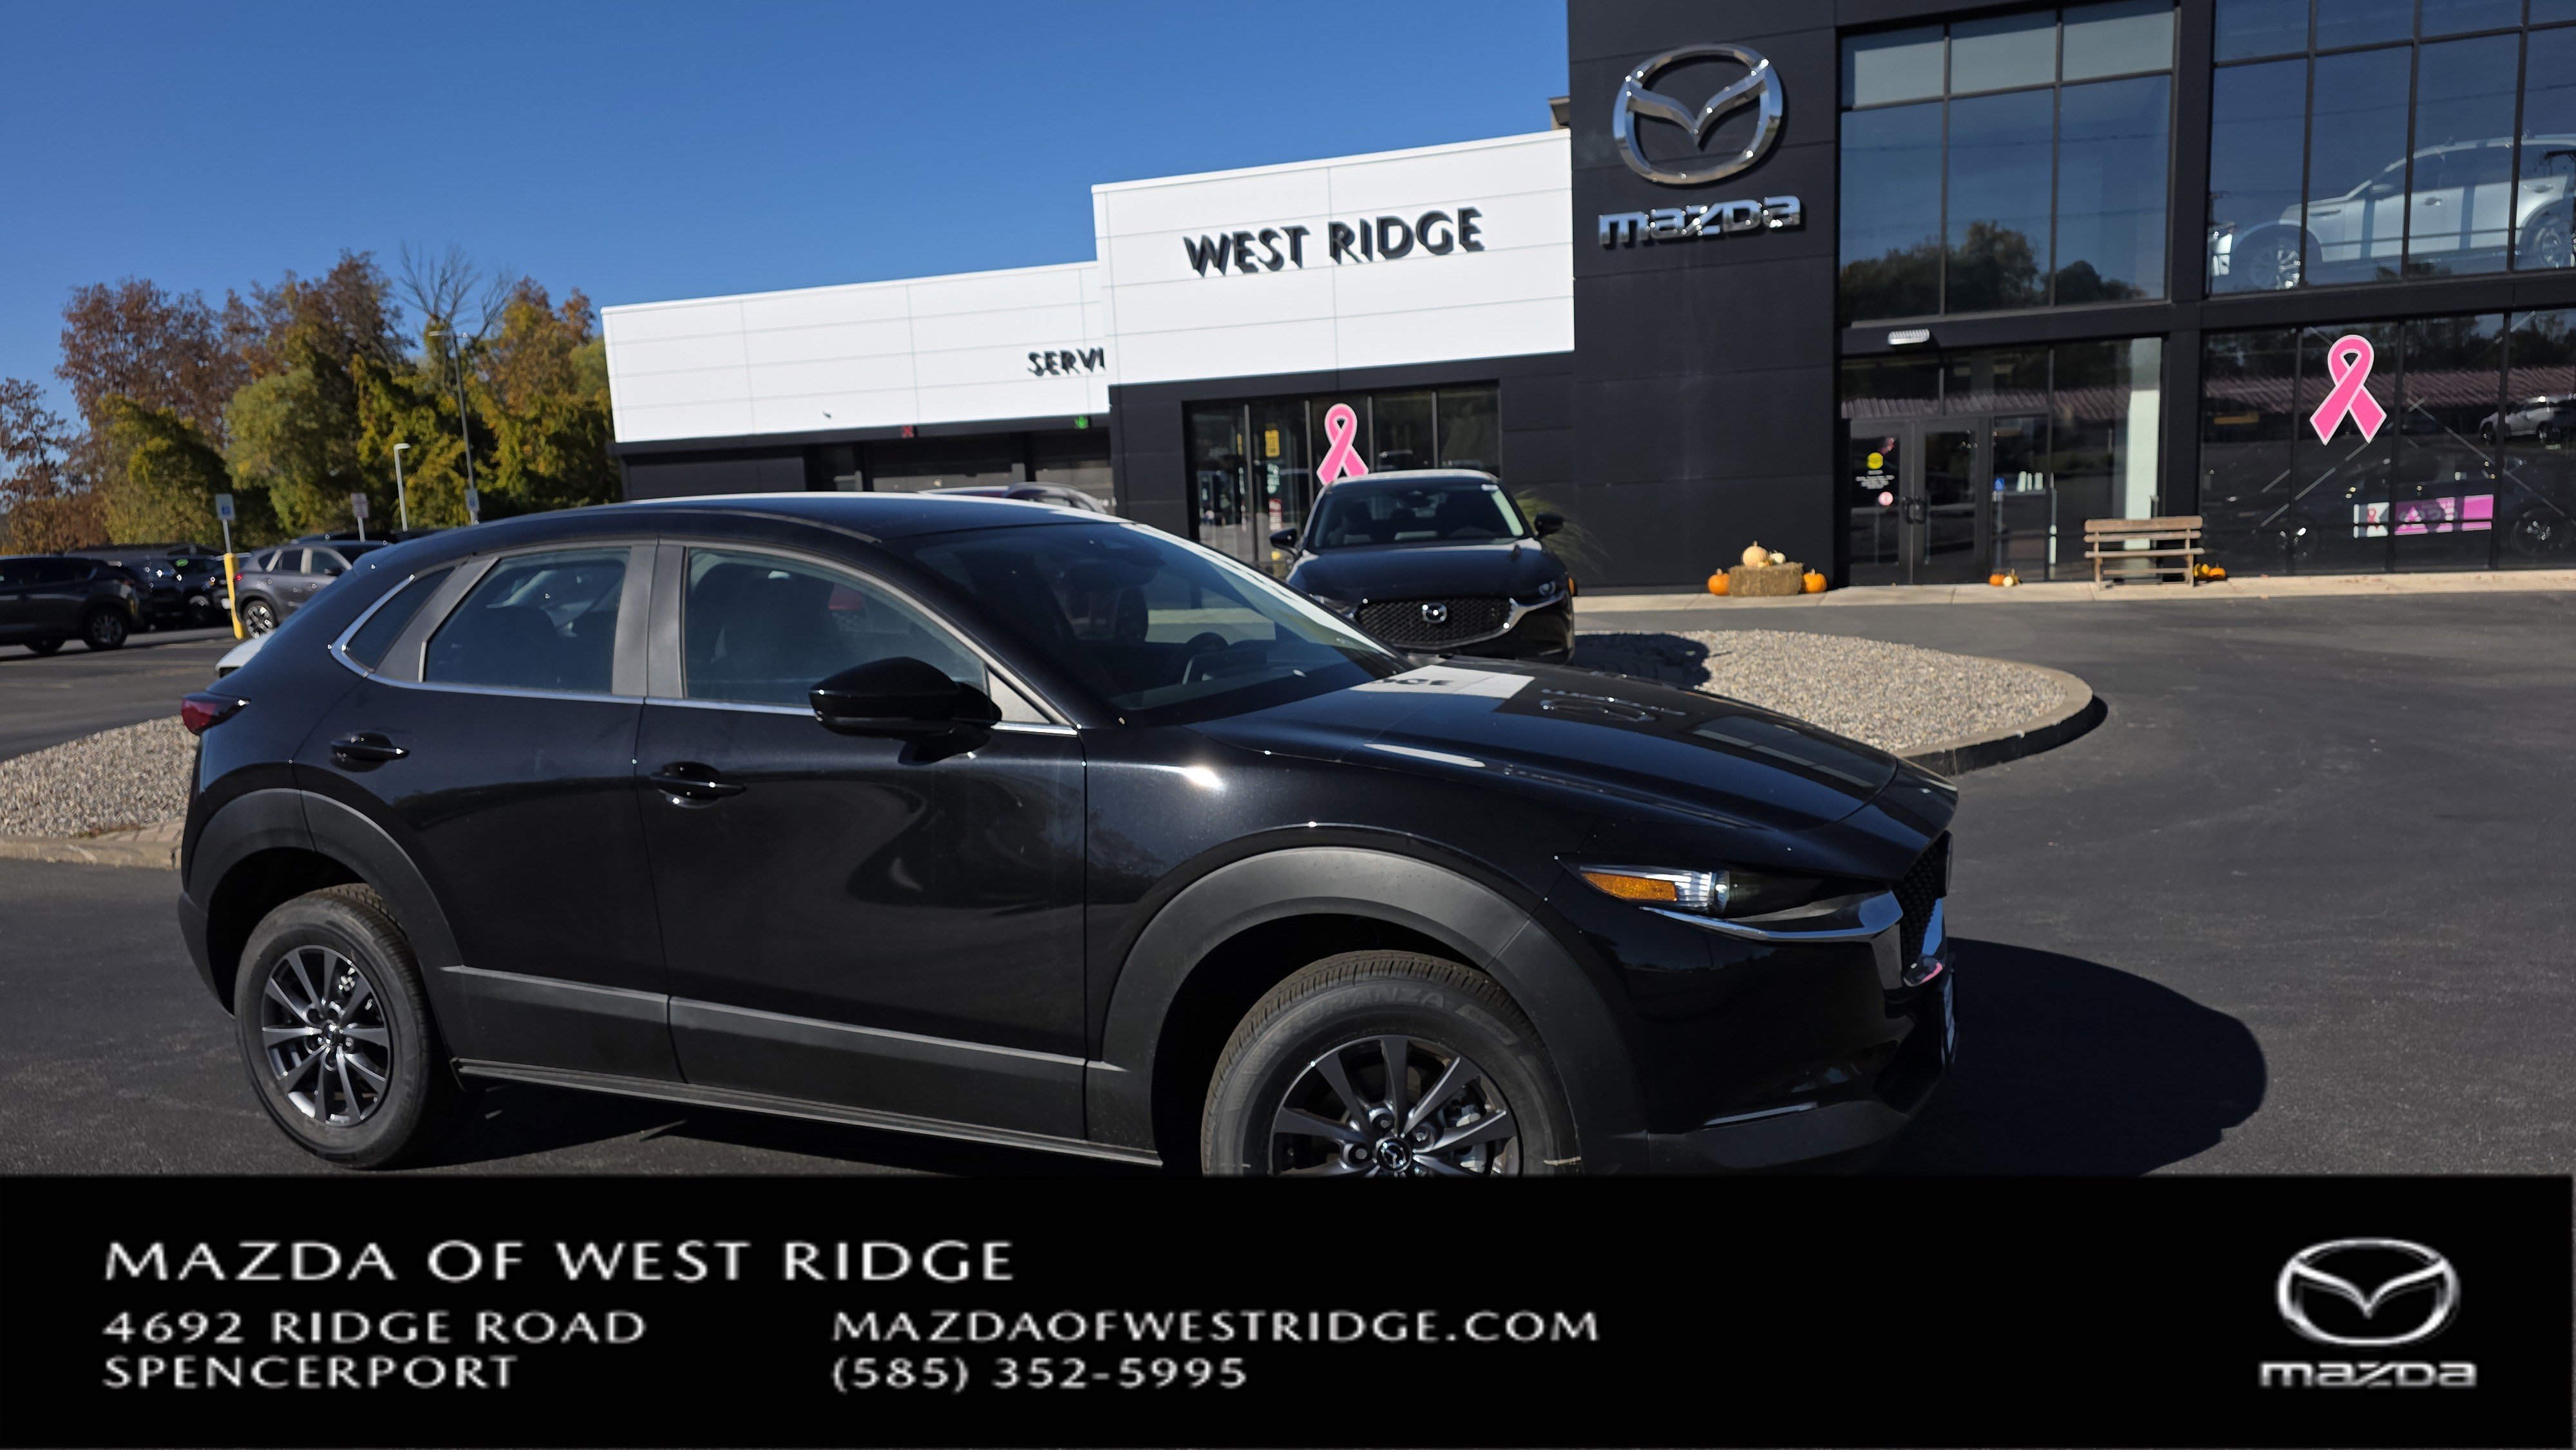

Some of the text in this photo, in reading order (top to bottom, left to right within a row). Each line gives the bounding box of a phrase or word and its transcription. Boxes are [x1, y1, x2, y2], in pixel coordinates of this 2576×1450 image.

[1183, 206, 1485, 278] WEST RIDGE
[1597, 195, 1801, 245] mazda
[1027, 347, 1106, 377] SERVI
